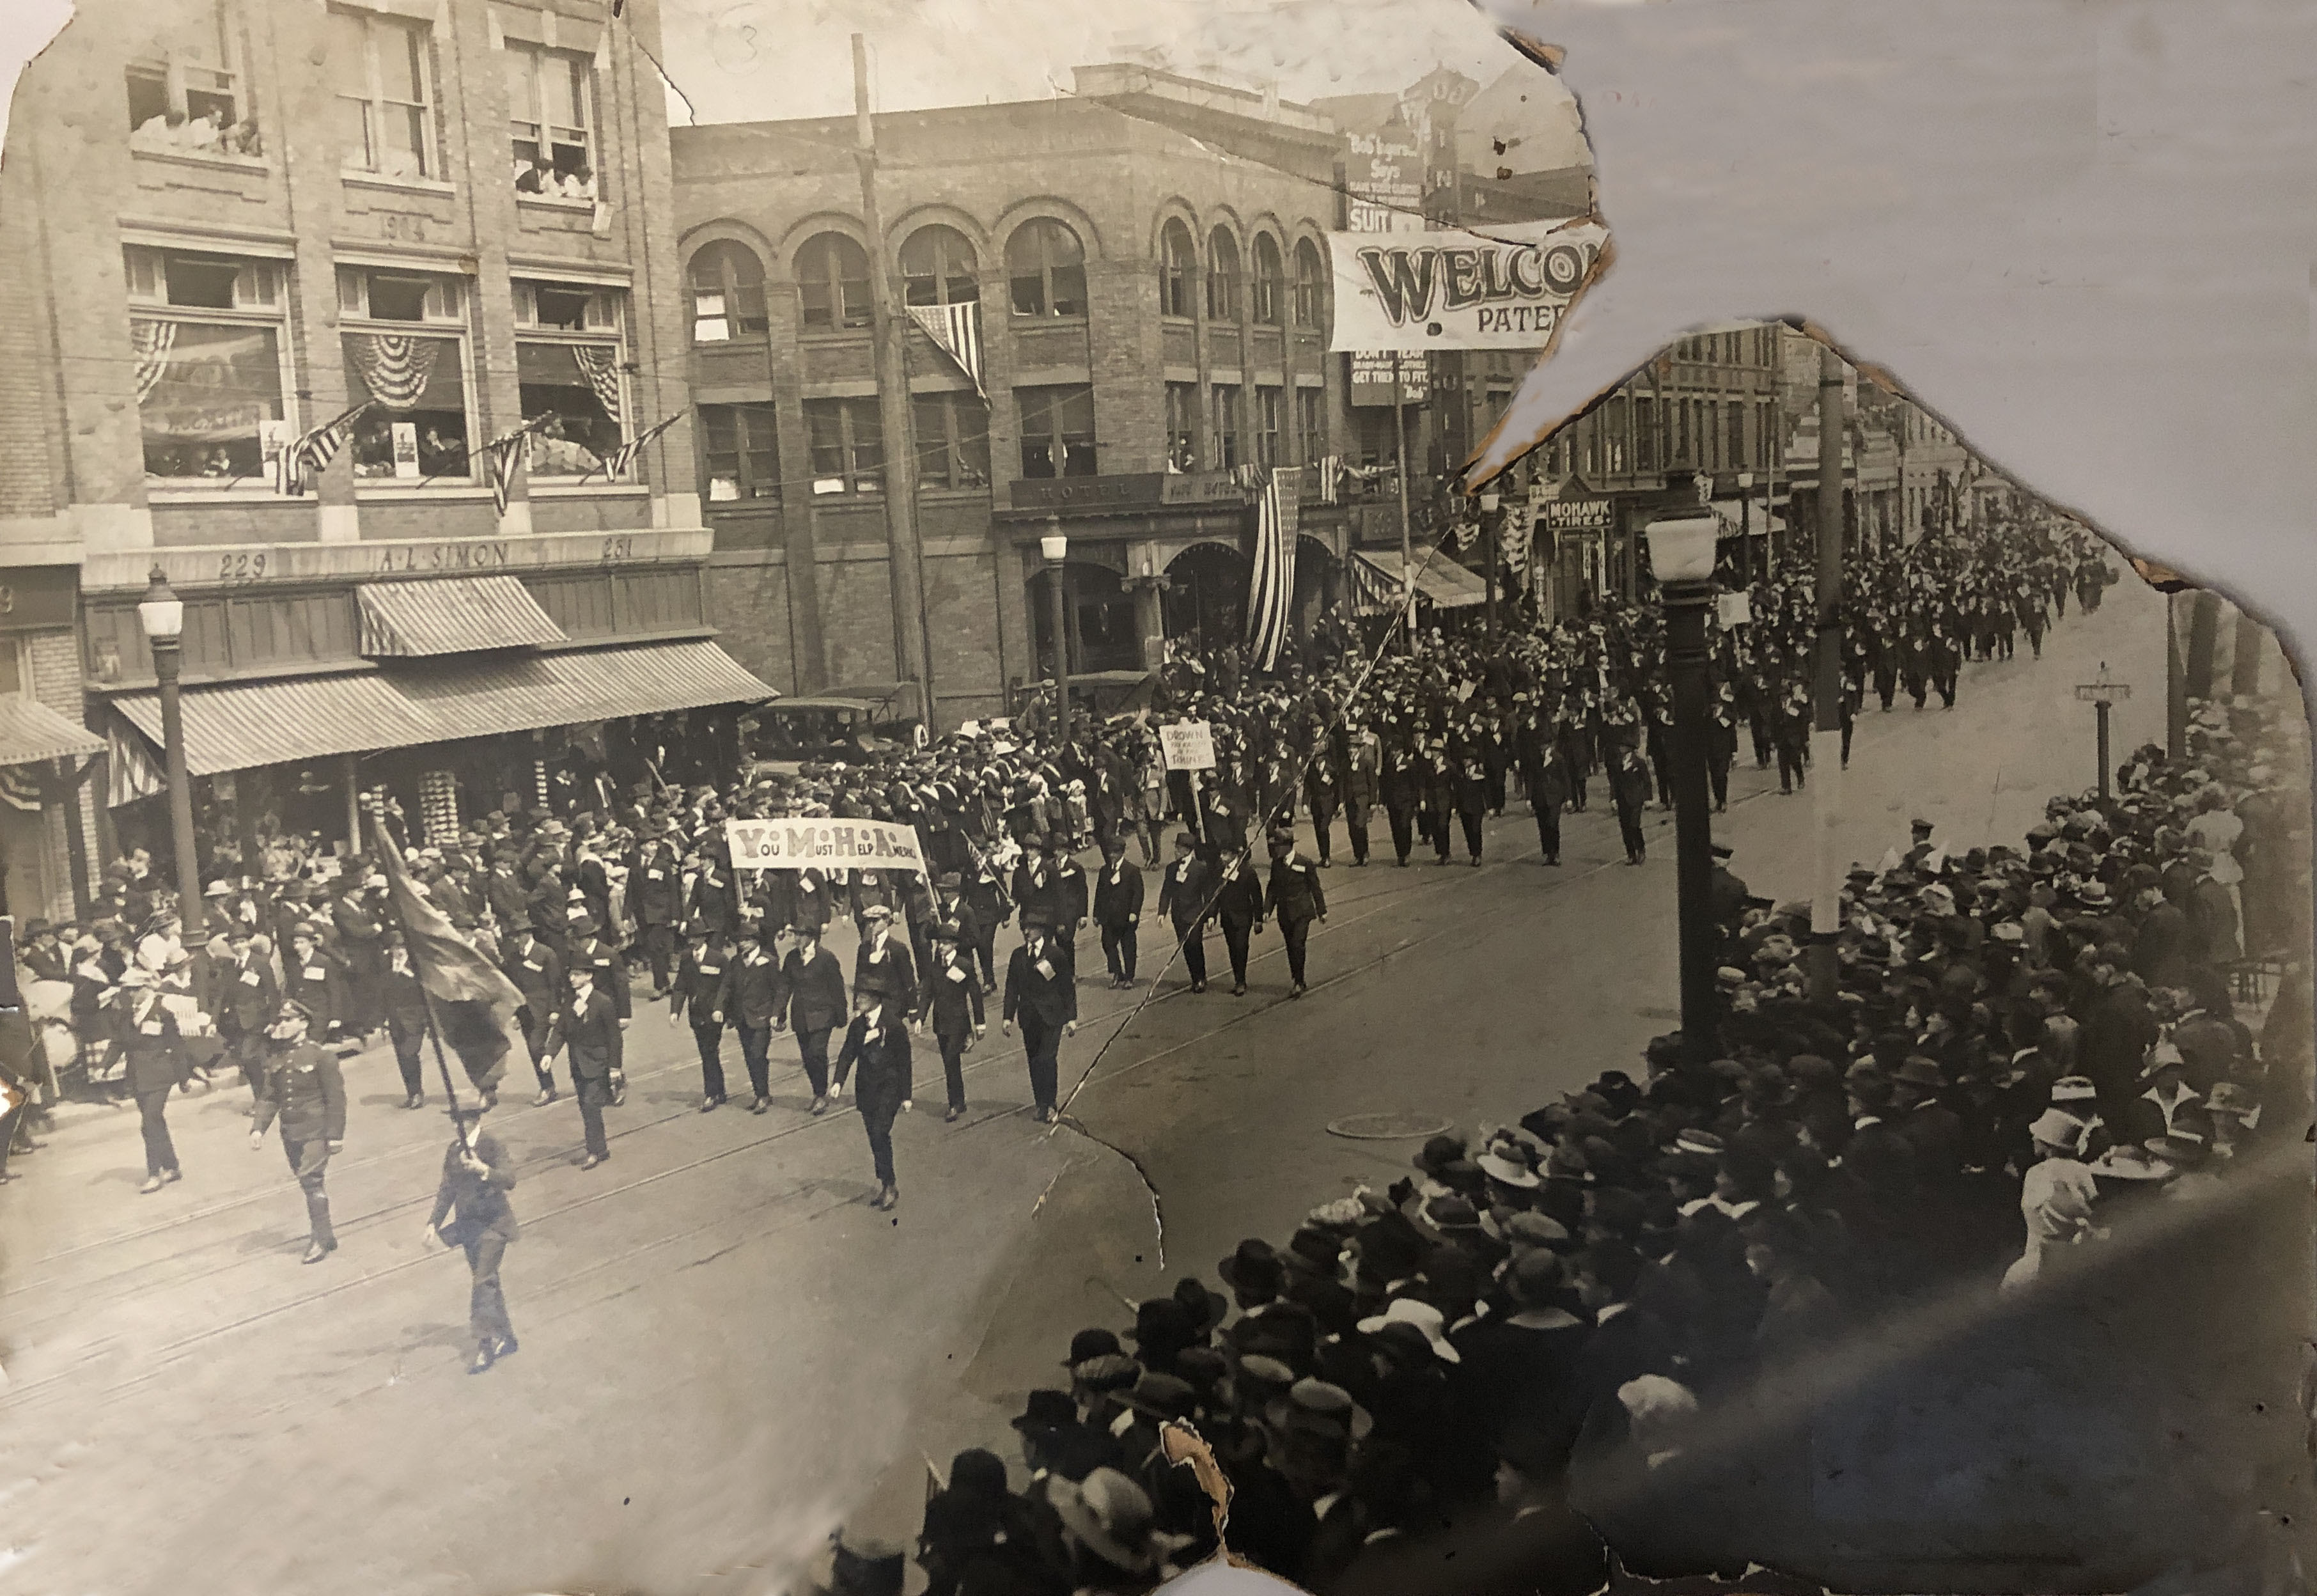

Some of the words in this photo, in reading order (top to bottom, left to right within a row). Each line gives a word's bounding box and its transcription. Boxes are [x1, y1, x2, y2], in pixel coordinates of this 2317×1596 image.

[1350, 208, 1389, 232] SUIT
[1352, 371, 1369, 384] GET
[1399, 371, 1410, 382] TO
[1550, 500, 1611, 517] MOHAWK
[1557, 515, 1604, 527] TIRES
[432, 542, 509, 568] SIMON
[220, 553, 267, 579] 229
